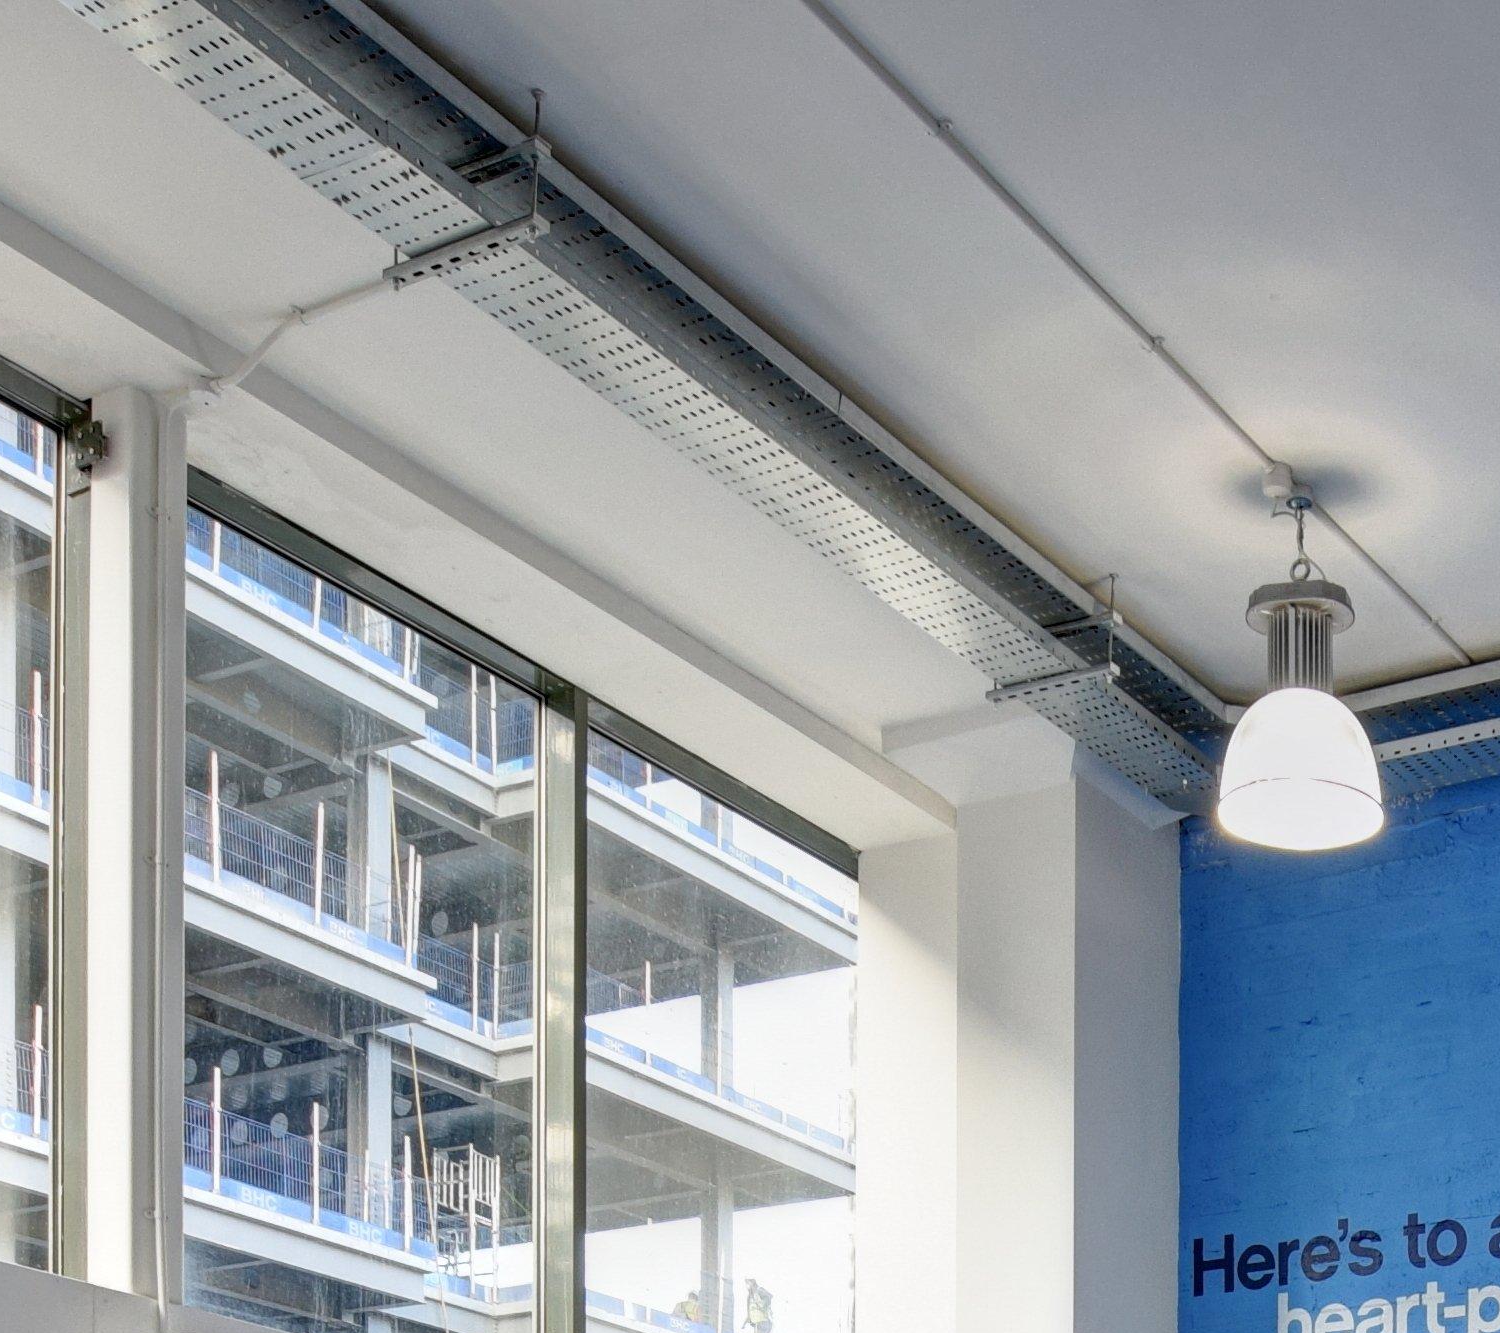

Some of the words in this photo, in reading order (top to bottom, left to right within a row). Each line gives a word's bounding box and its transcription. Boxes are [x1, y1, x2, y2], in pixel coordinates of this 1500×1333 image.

[241, 1187, 278, 1212] BHC
[350, 1223, 383, 1243] BHC
[1192, 1215, 1383, 1297] Here's
[1402, 1213, 1468, 1269] to
